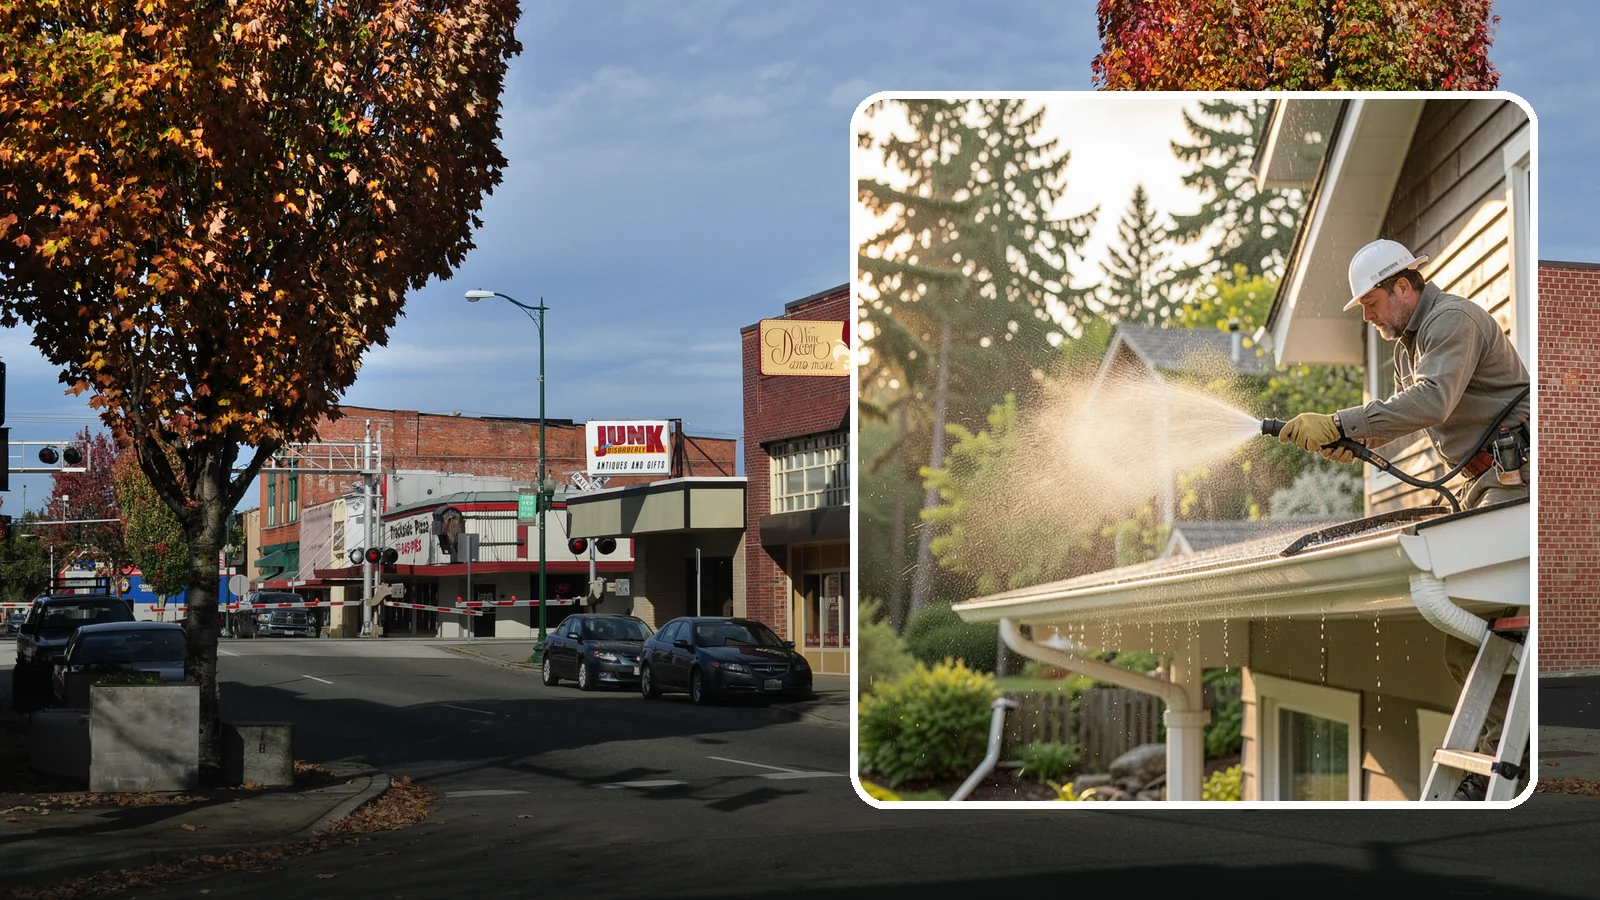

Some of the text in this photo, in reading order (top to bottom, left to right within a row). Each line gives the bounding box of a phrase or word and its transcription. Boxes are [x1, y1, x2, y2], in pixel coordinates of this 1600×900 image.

[595, 425, 665, 457] JUNK
[607, 446, 646, 454] DISORDERLY
[597, 460, 665, 470] ANTIQUES AND GIFTS
[590, 476, 608, 492] SING
[390, 519, 429, 540] Trackside Pizza
